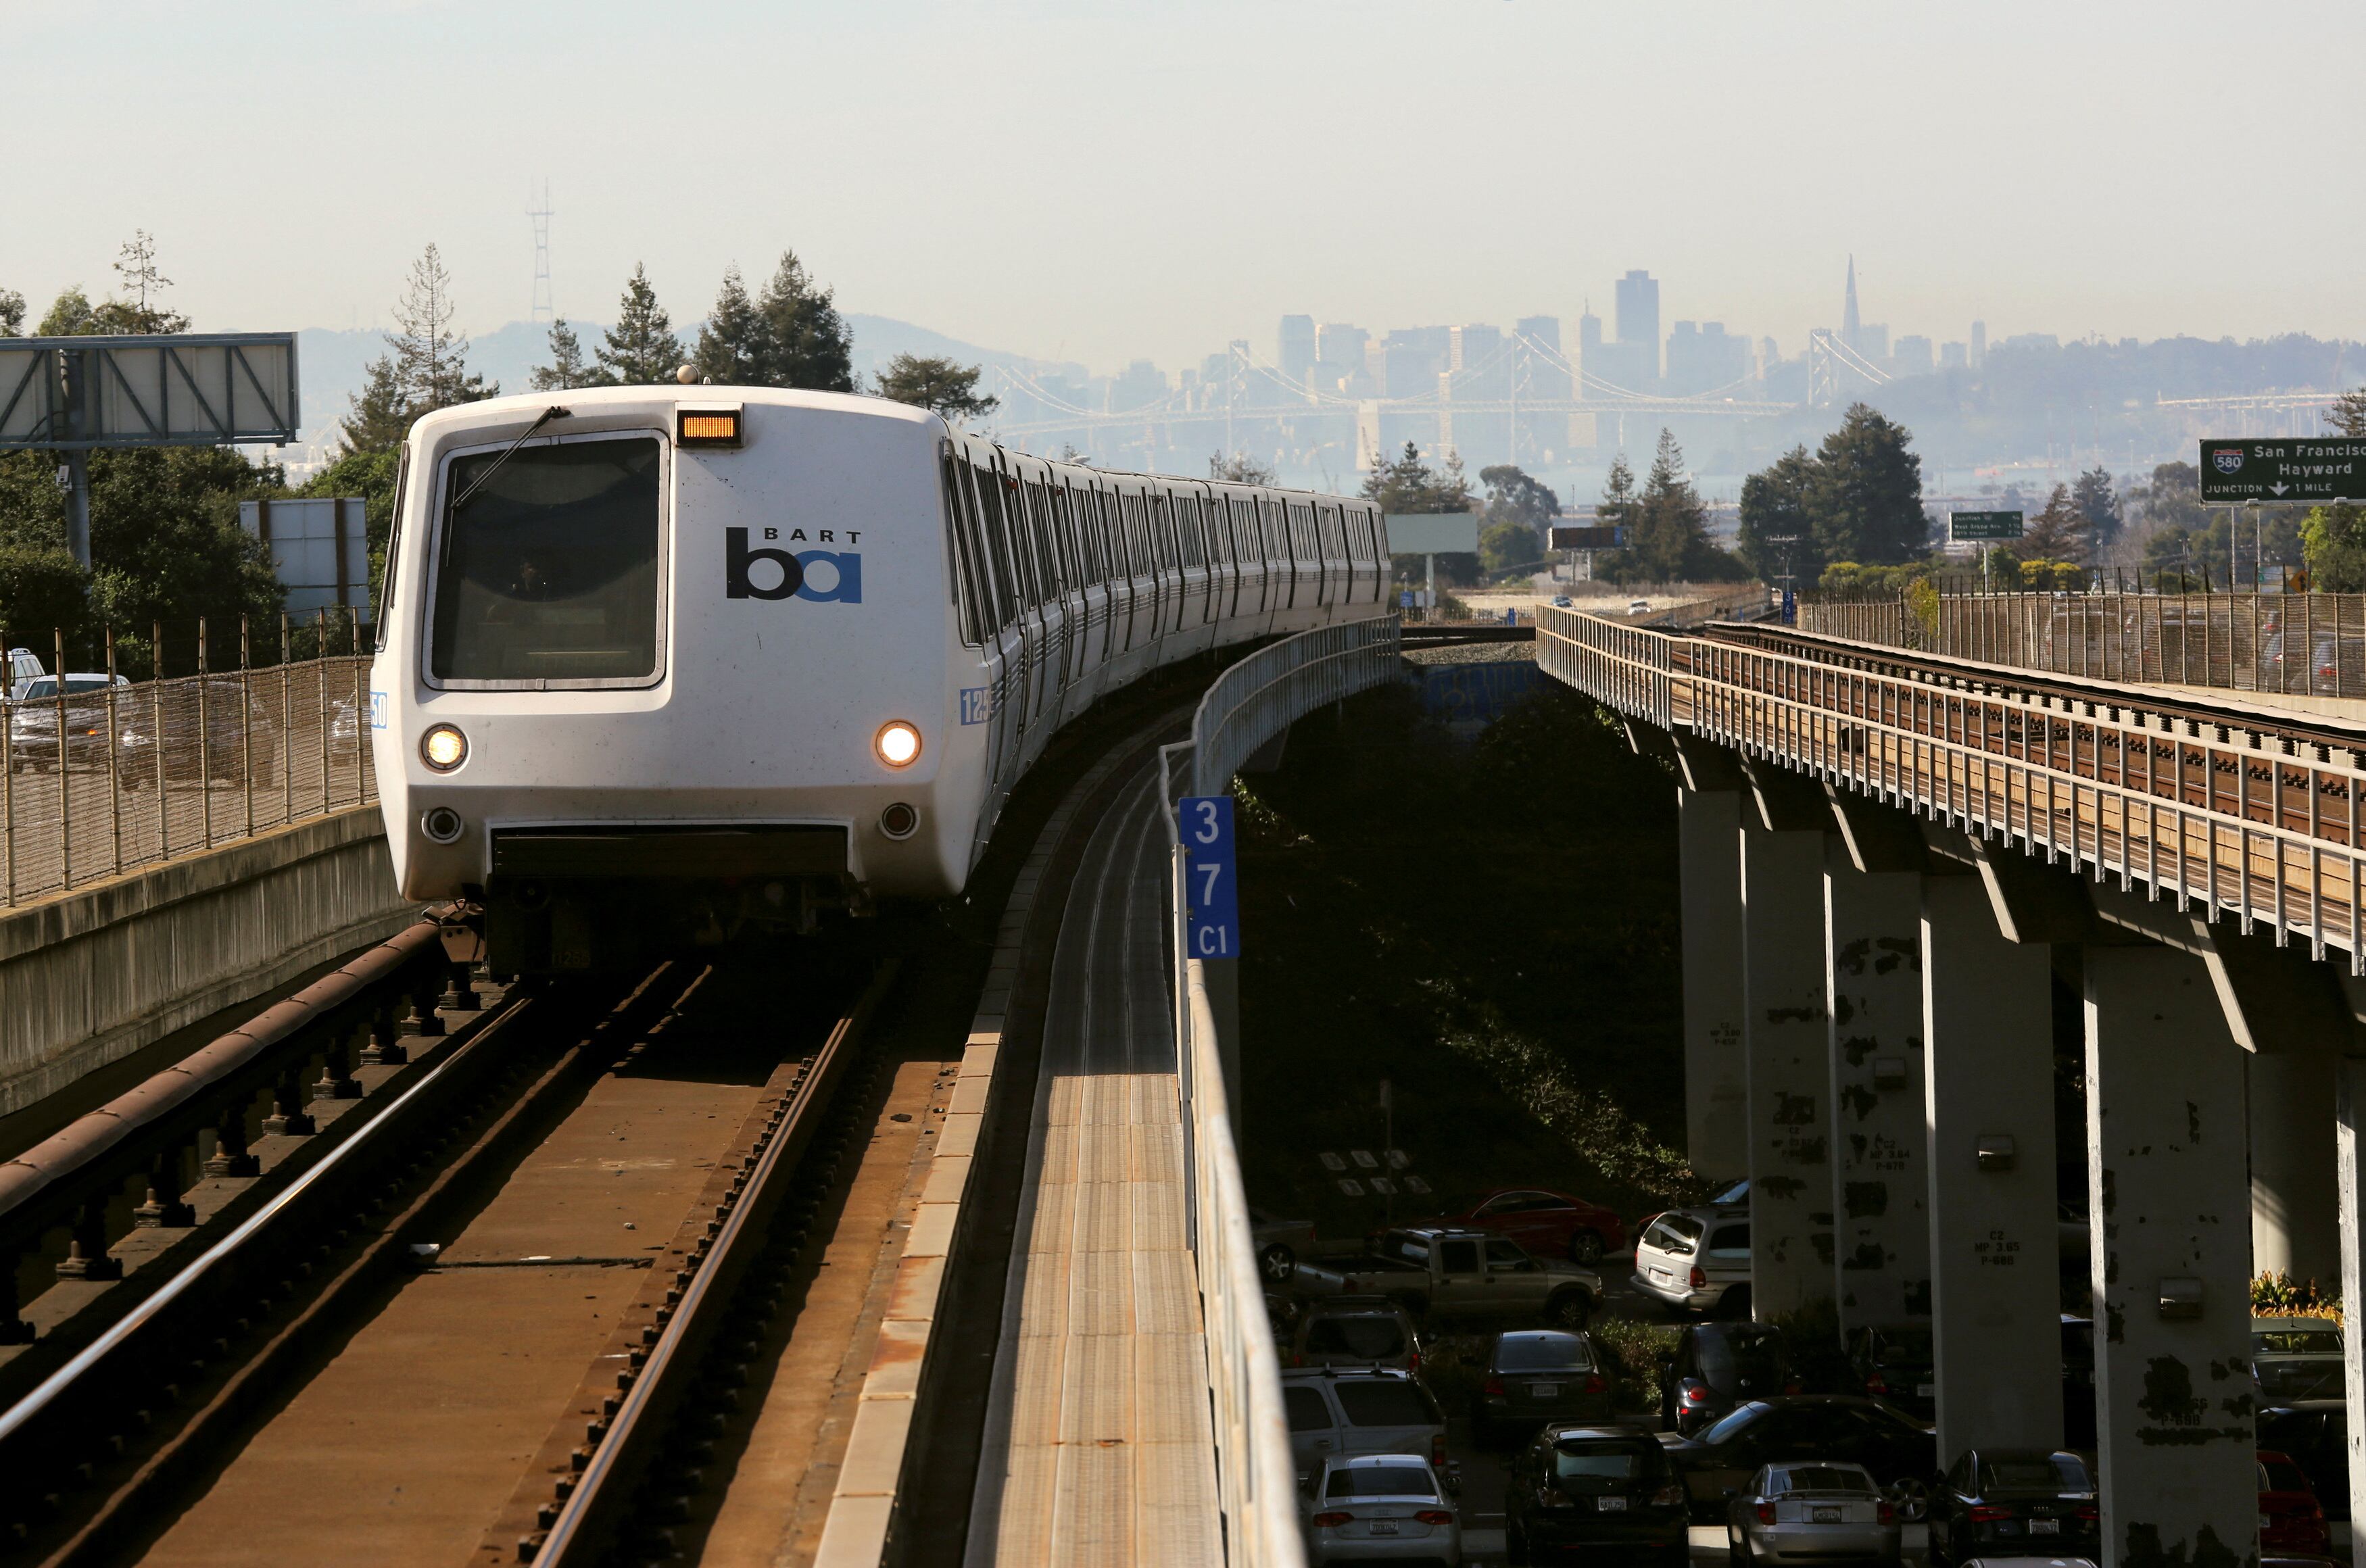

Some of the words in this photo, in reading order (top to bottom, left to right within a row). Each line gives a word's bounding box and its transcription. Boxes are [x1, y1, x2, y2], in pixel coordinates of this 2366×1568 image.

[2254, 445, 2285, 458] San
[2217, 456, 2241, 468] 580
[2279, 463, 2352, 478] Hayward
[2206, 485, 2263, 493] JUNCTION
[2295, 483, 2300, 492] 1
[2304, 483, 2332, 492] MILE
[764, 527, 861, 544] BART
[1785, 592, 1791, 602] 3
[1785, 605, 1791, 614] 6
[1195, 800, 1219, 843] 3
[1197, 864, 1221, 906] 7
[1199, 925, 1227, 954] C1
[1789, 1127, 1800, 1135] C2
[1883, 1140, 1896, 1149] C2
[1870, 1150, 1883, 1159] MP
[1989, 1231, 2004, 1240] C2
[1974, 1242, 1989, 1252] MP
